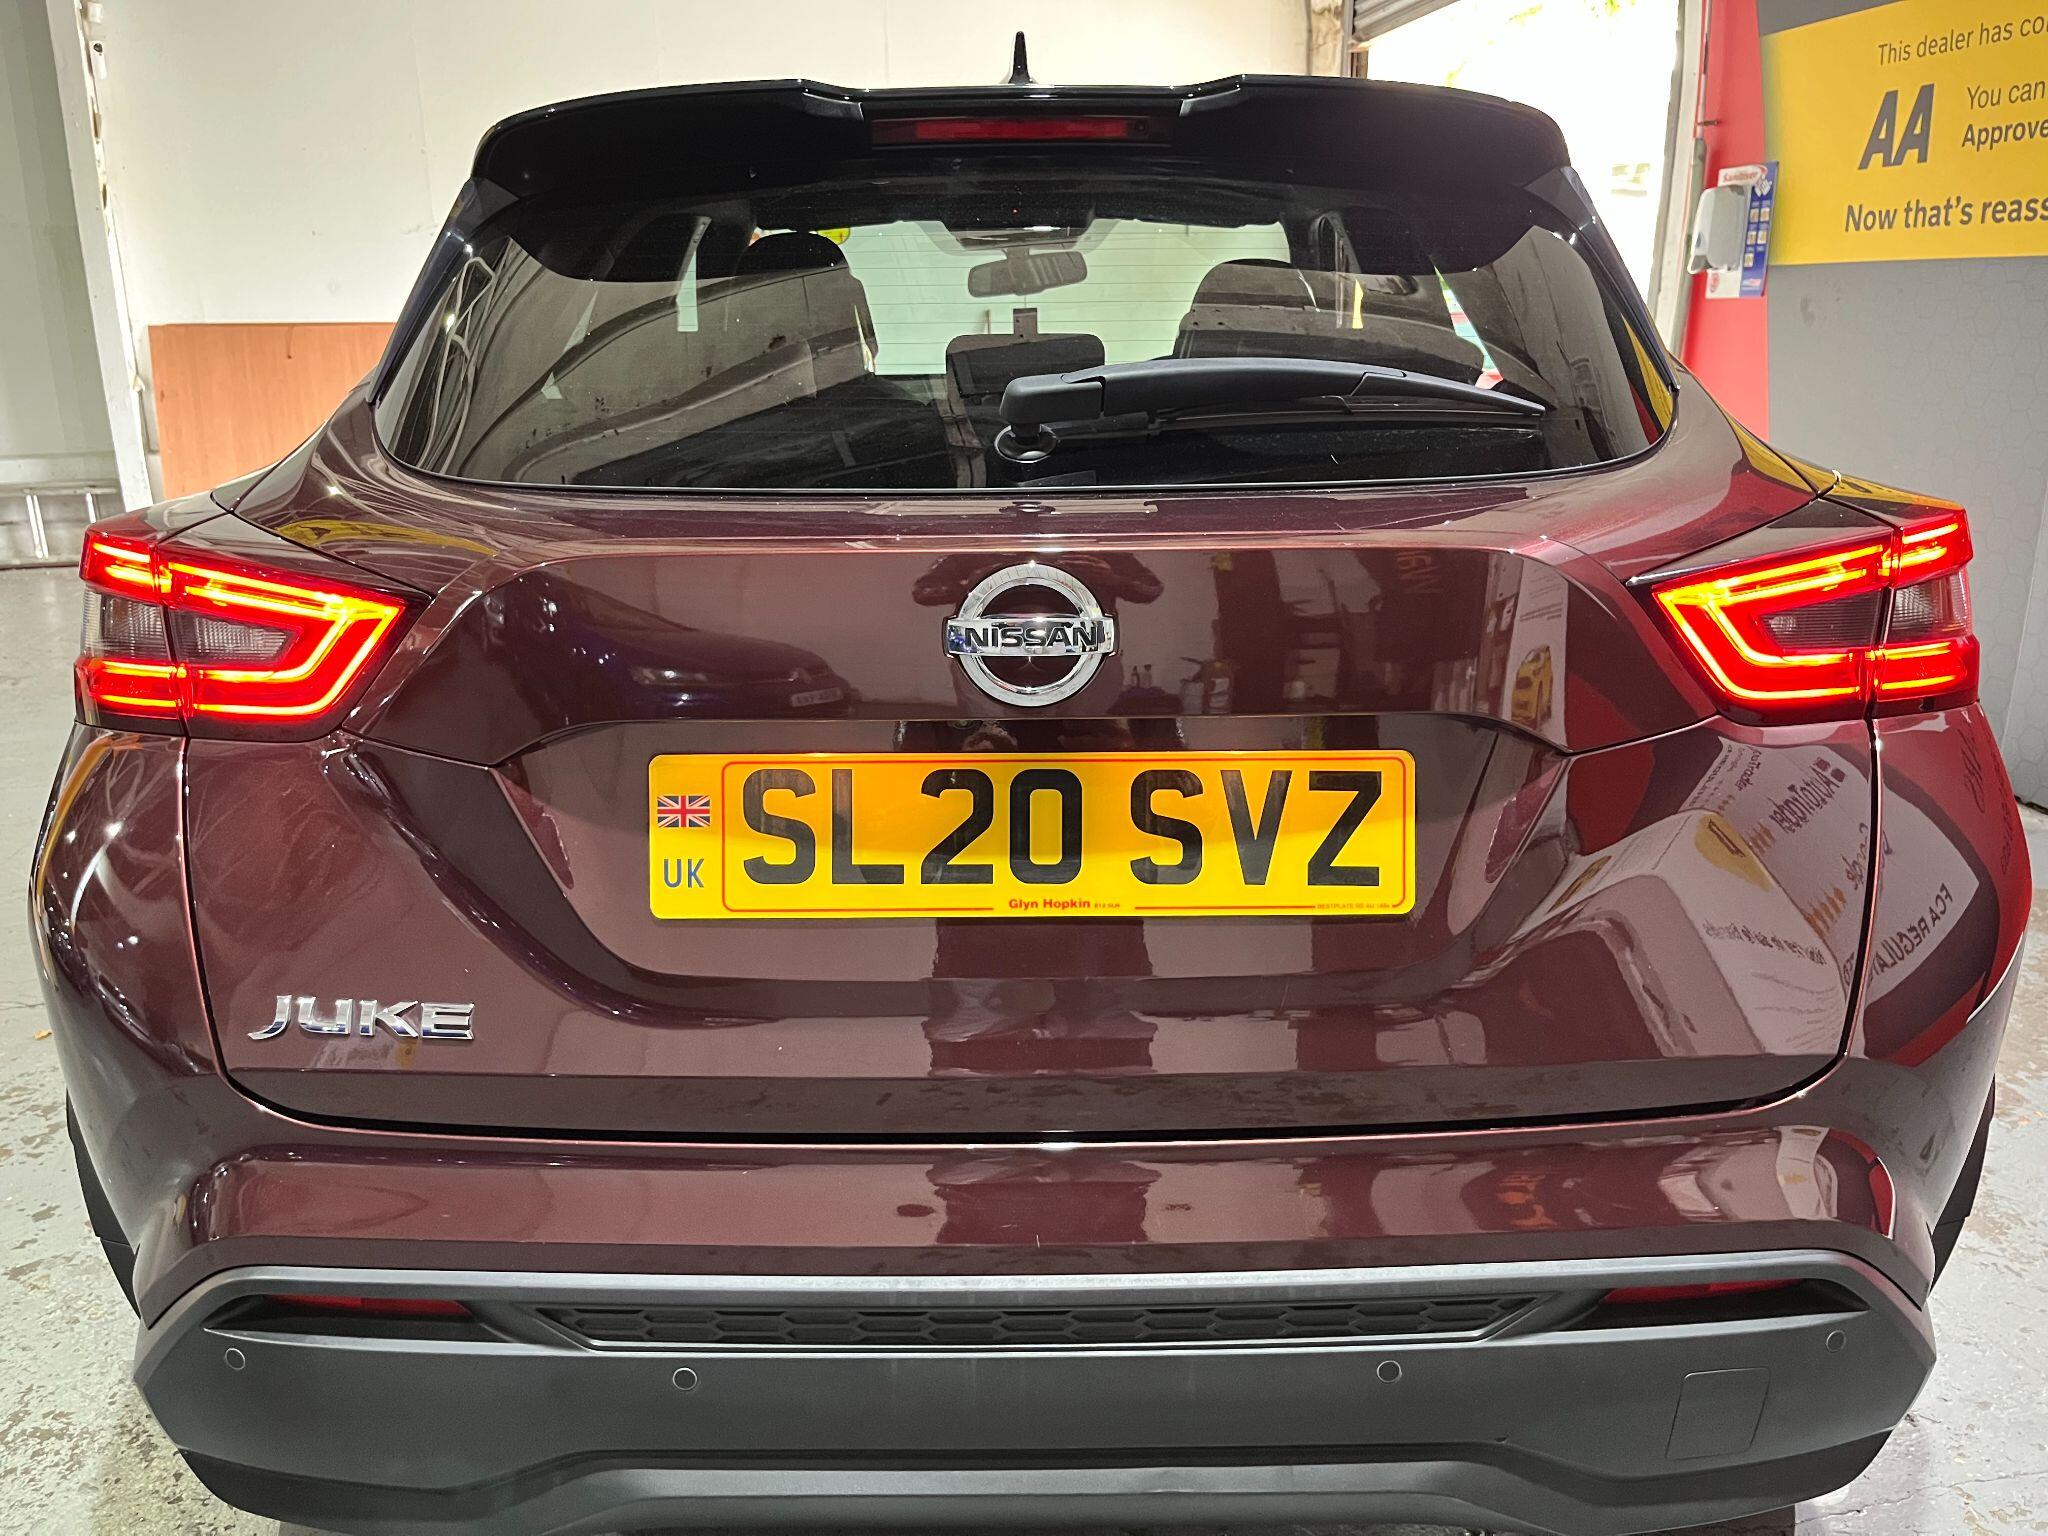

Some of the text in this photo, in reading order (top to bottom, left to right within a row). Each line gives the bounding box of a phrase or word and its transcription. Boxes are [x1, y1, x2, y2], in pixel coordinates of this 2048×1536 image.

[1878, 16, 2048, 66] This dealer has co
[1967, 80, 2046, 110] You can
[1858, 83, 1935, 170] AA
[1845, 203, 1896, 232] Now
[1904, 196, 1973, 229] that's
[964, 626, 1097, 648] NISSAN
[743, 768, 1383, 886] SL20 SVZ
[663, 858, 705, 888] UK
[1008, 898, 1039, 911] Glyn
[1043, 897, 1091, 911] Hopkin
[247, 994, 475, 1041] JUKE
